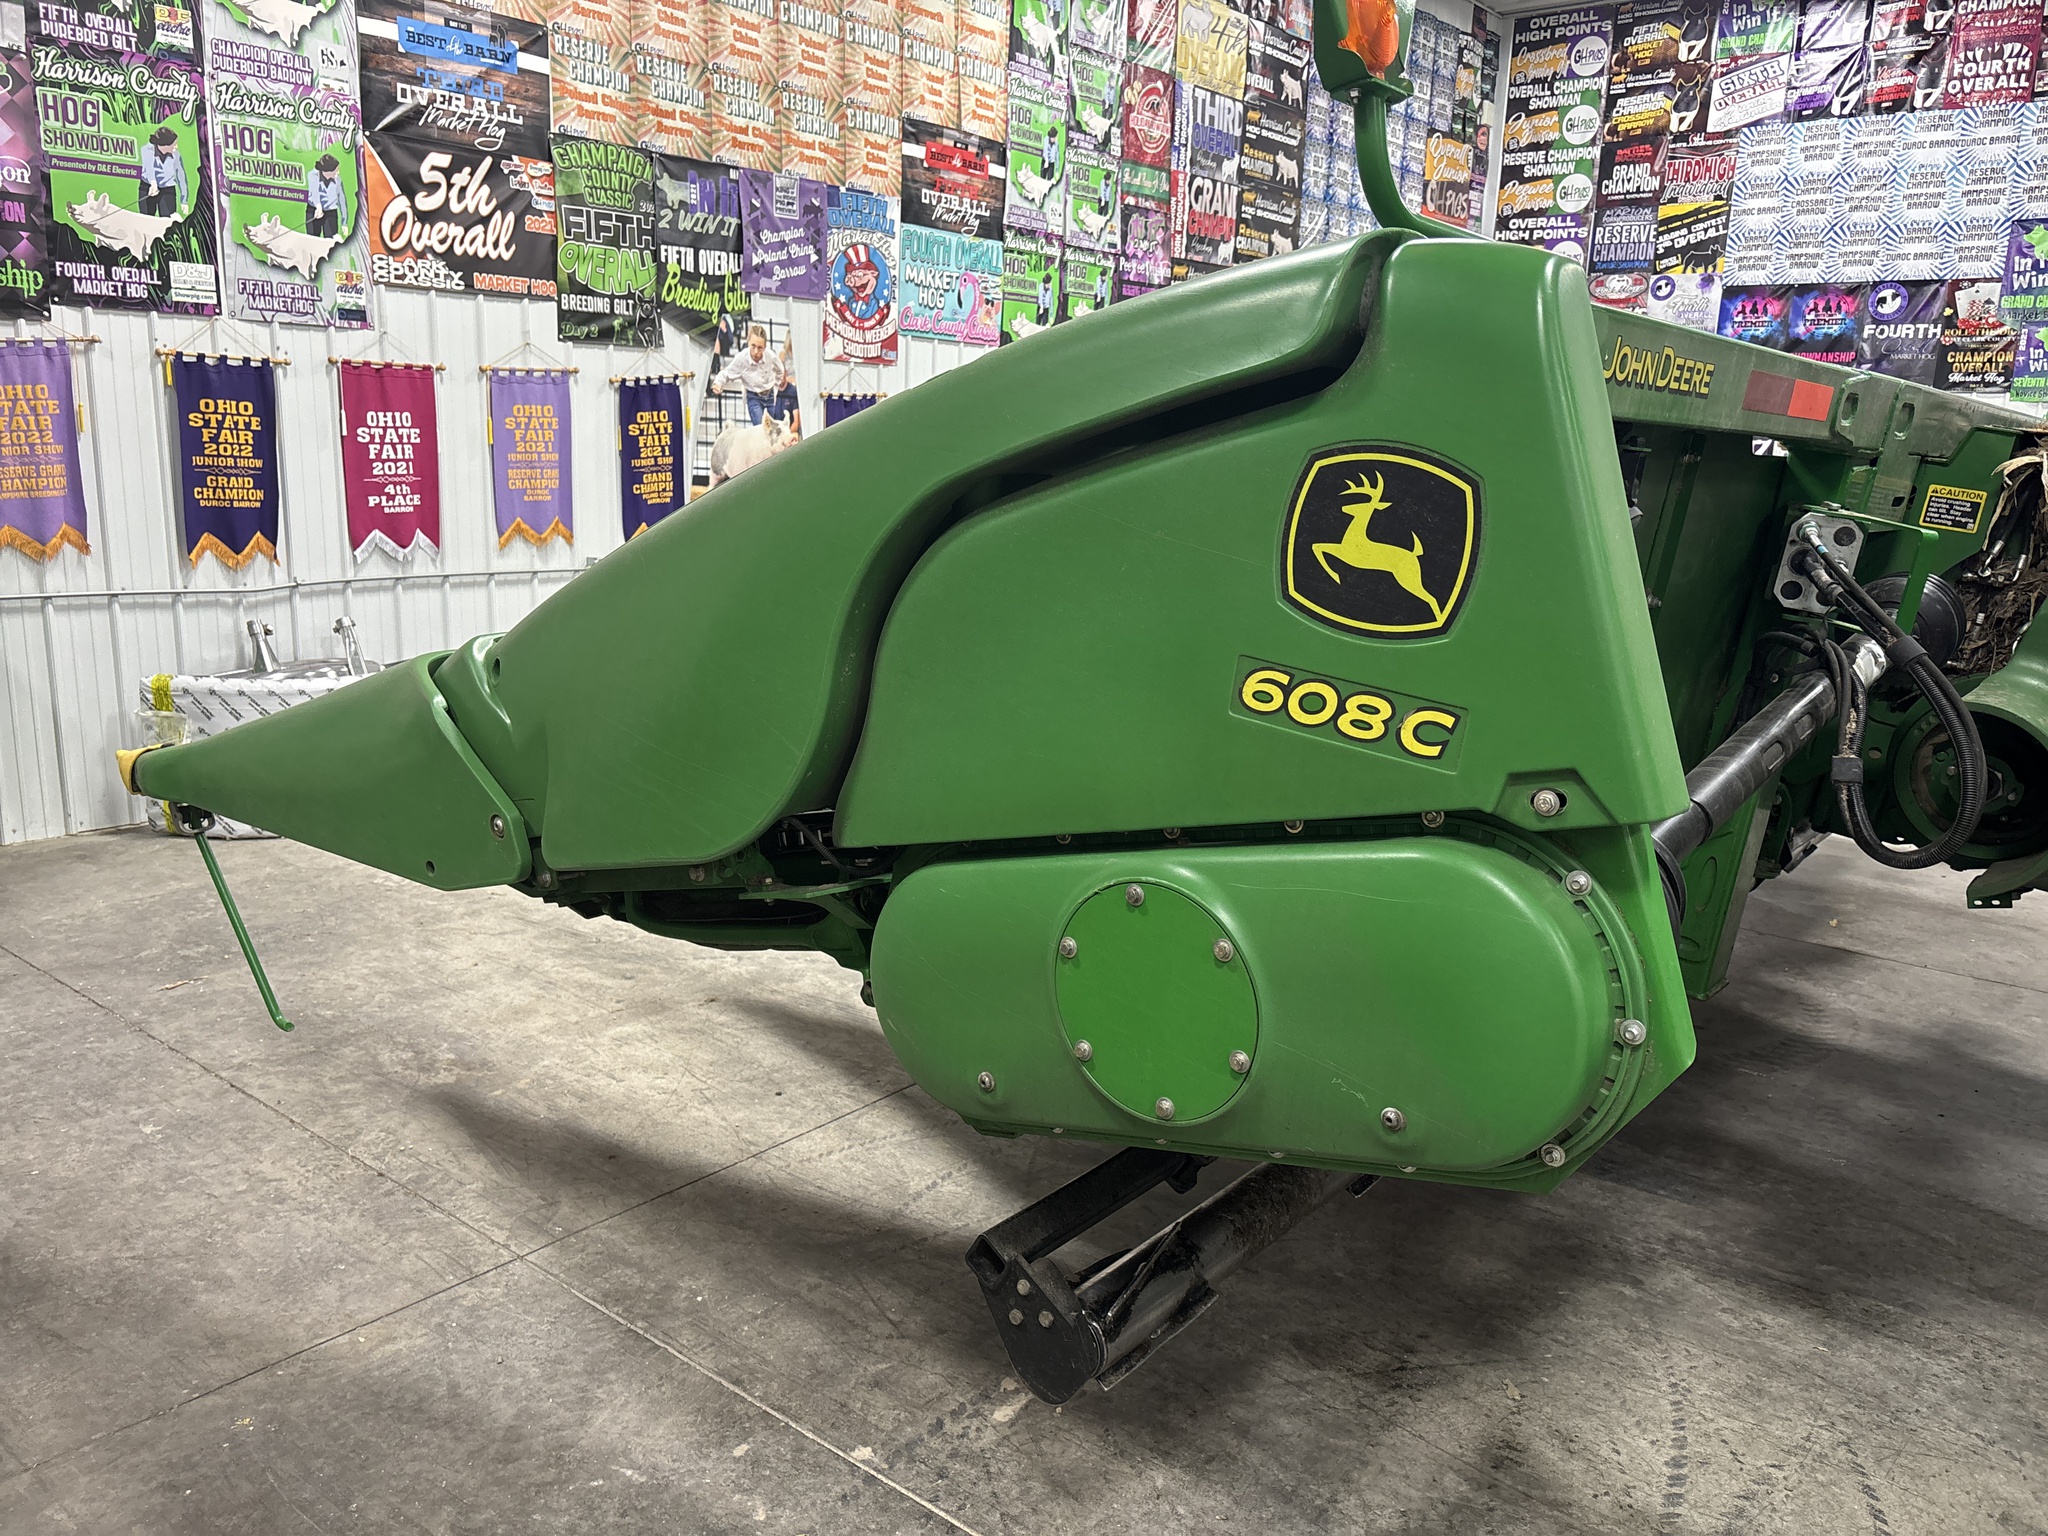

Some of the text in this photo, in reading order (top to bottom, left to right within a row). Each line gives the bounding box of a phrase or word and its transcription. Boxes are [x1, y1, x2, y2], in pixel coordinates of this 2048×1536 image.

[38, 2, 138, 36] FIFTH OVERALL
[1530, 10, 1599, 29] OVERALL
[41, 19, 108, 46] PUREBRED
[112, 33, 138, 52] GILT
[1515, 20, 1613, 44] HIGH POINTS
[1624, 31, 1670, 46] OVERALL
[1632, 22, 1662, 36] FIFTH
[212, 39, 267, 63] CHAMPION
[270, 50, 311, 72] OVERALL
[405, 29, 446, 49] BEST
[464, 43, 512, 63] BARN
[554, 33, 611, 66] RESERVE
[904, 38, 955, 72] CHAMPION
[1627, 40, 1665, 53] MARKET
[1634, 49, 1654, 59] HOG
[569, 59, 632, 94] CHAMPION
[637, 54, 688, 83] RESERVE
[1953, 57, 2031, 78] FOURTH
[34, 48, 198, 122] Harrison County
[713, 73, 760, 100] RESERVE
[1719, 60, 1785, 95] SIXTH
[1947, 74, 2031, 95] OVERALL
[651, 79, 706, 110] CHAMPION
[1509, 76, 1608, 100] OVERALL CHAMPION
[1713, 78, 1786, 111] OVERALL
[42, 92, 99, 127] HOG
[397, 83, 523, 125] OVERALL
[783, 91, 826, 119] RESERVE
[1528, 93, 1581, 111] SHOWMAN
[1612, 101, 1667, 117] CHAMPION
[1616, 92, 1665, 109] RESERVE
[216, 83, 356, 149] Harrison County
[725, 97, 775, 126] CHAMPION
[1010, 104, 1032, 126] HOG
[1194, 88, 1244, 137] THIRD
[794, 113, 840, 141] CHAMPION
[1174, 109, 1182, 148] MARION
[1805, 123, 1841, 135] RESERVE
[44, 129, 135, 157] SHOWDOWN
[223, 124, 271, 155] HOG
[1802, 131, 1841, 143] CHAMPION
[553, 140, 653, 182] CHAMPAIGN
[1243, 143, 1274, 164] Reserve
[1503, 150, 1547, 166] RESERVE
[1547, 146, 1601, 163] CHAMPION
[1803, 151, 1836, 163] BARROW
[51, 159, 138, 176] Presented by D&E Electric
[225, 156, 302, 181] SHOWDOWN
[1523, 162, 1576, 178] SHOWMAN
[1612, 162, 1651, 181] GRAND
[415, 152, 497, 217] 5th
[581, 167, 635, 193] COUNTY
[1601, 176, 1660, 195] CHAMPION
[584, 186, 633, 212] CLASSIC
[1501, 180, 1555, 200] Peewee
[840, 192, 888, 216] FIFTH
[921, 189, 991, 217] OVERALL
[1795, 205, 1827, 216] BARROW
[381, 195, 516, 261] Overall
[525, 217, 556, 235] 2021
[562, 204, 656, 249] FIFTH
[828, 208, 896, 236] OVERALL
[1508, 216, 1576, 229] OVERALL
[760, 226, 806, 244] Champion
[1495, 226, 1588, 241] HIGH POINTS
[1595, 224, 1658, 244] RESERVE
[1674, 225, 1729, 250] OVERALL
[1957, 231, 2000, 243] CHAMPION
[901, 229, 1004, 275] FOURTH OVERALL
[1004, 232, 1037, 255] Harrison
[1037, 239, 1062, 272] County
[1593, 242, 1655, 262] CHAMPION
[1953, 244, 2000, 255] HAMPSHIRE
[1957, 253, 1993, 264] BARROW
[372, 254, 446, 270] CLARK
[372, 262, 464, 280] COUNTY
[559, 241, 657, 295] OVERALL
[1005, 256, 1027, 276] HOG
[56, 261, 105, 280] FOURTH
[112, 267, 161, 286] OVERALL
[905, 264, 960, 291] MARKET
[74, 279, 148, 299] MARKET HOG
[238, 279, 320, 300] FIFTH OVERALL
[474, 273, 557, 297] MARKET HOG
[661, 262, 750, 325] Breeding Gilt
[561, 295, 635, 316] BREEDING GILT
[918, 288, 946, 309] HOG
[2001, 296, 2034, 309] GRAND
[1863, 324, 1943, 340] FOURTH
[1602, 335, 1716, 397] JOHN DEERE
[1946, 351, 2015, 363] CHAMPION
[1952, 362, 2006, 374] OVERALL
[199, 399, 254, 415] OHIO
[512, 404, 554, 417] OHIO
[188, 414, 262, 431] STATE
[366, 411, 412, 428] OHIO
[504, 417, 559, 430] STATE
[636, 410, 669, 424] OHIO
[202, 429, 254, 445] FAIR
[356, 427, 421, 444] STATE
[514, 429, 555, 442] FAIR
[628, 422, 673, 435] STATE
[204, 443, 254, 457] 2022
[516, 442, 554, 453] 2021
[638, 434, 671, 448] FAIR
[368, 443, 415, 459] FAIR
[507, 453, 538, 462] JUNIOR
[639, 446, 670, 459] 2021
[191, 456, 264, 468] JUNIOR SHOW
[371, 461, 414, 476] 2021
[206, 476, 254, 489] GRAND
[507, 468, 541, 479] RESERVE
[194, 487, 264, 502] CHAMPION
[384, 484, 412, 496] 4th
[1939, 487, 1985, 501] CAUTION
[200, 500, 262, 509] DUROC BARROW
[367, 494, 422, 507] PLACE
[384, 505, 415, 514] BARROW
[1929, 501, 1973, 512] injuries. Header
[1947, 498, 1971, 508] crushing
[1930, 518, 1953, 526] running.
[1955, 515, 1974, 523] engine
